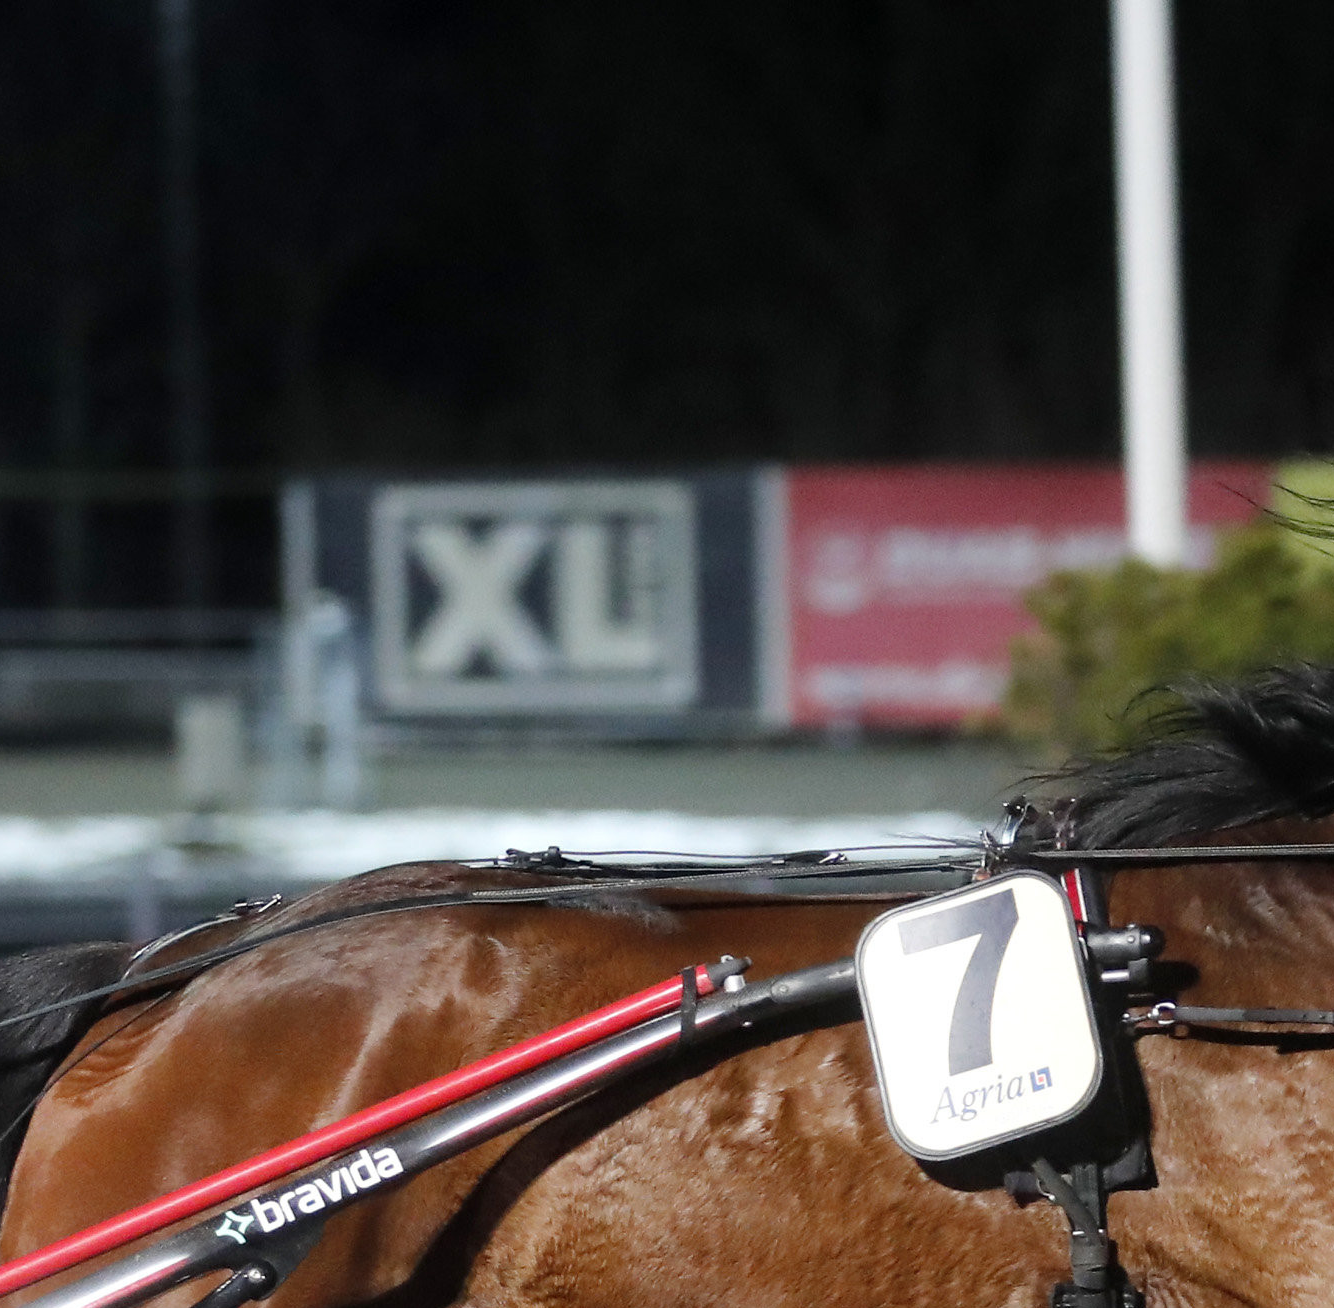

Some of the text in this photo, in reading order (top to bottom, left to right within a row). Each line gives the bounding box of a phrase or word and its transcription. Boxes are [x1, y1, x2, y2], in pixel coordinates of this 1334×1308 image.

[411, 520, 662, 672] XL
[898, 888, 1019, 1076] 7
[929, 1073, 1025, 1125] Agria
[250, 1148, 404, 1233] bravida
